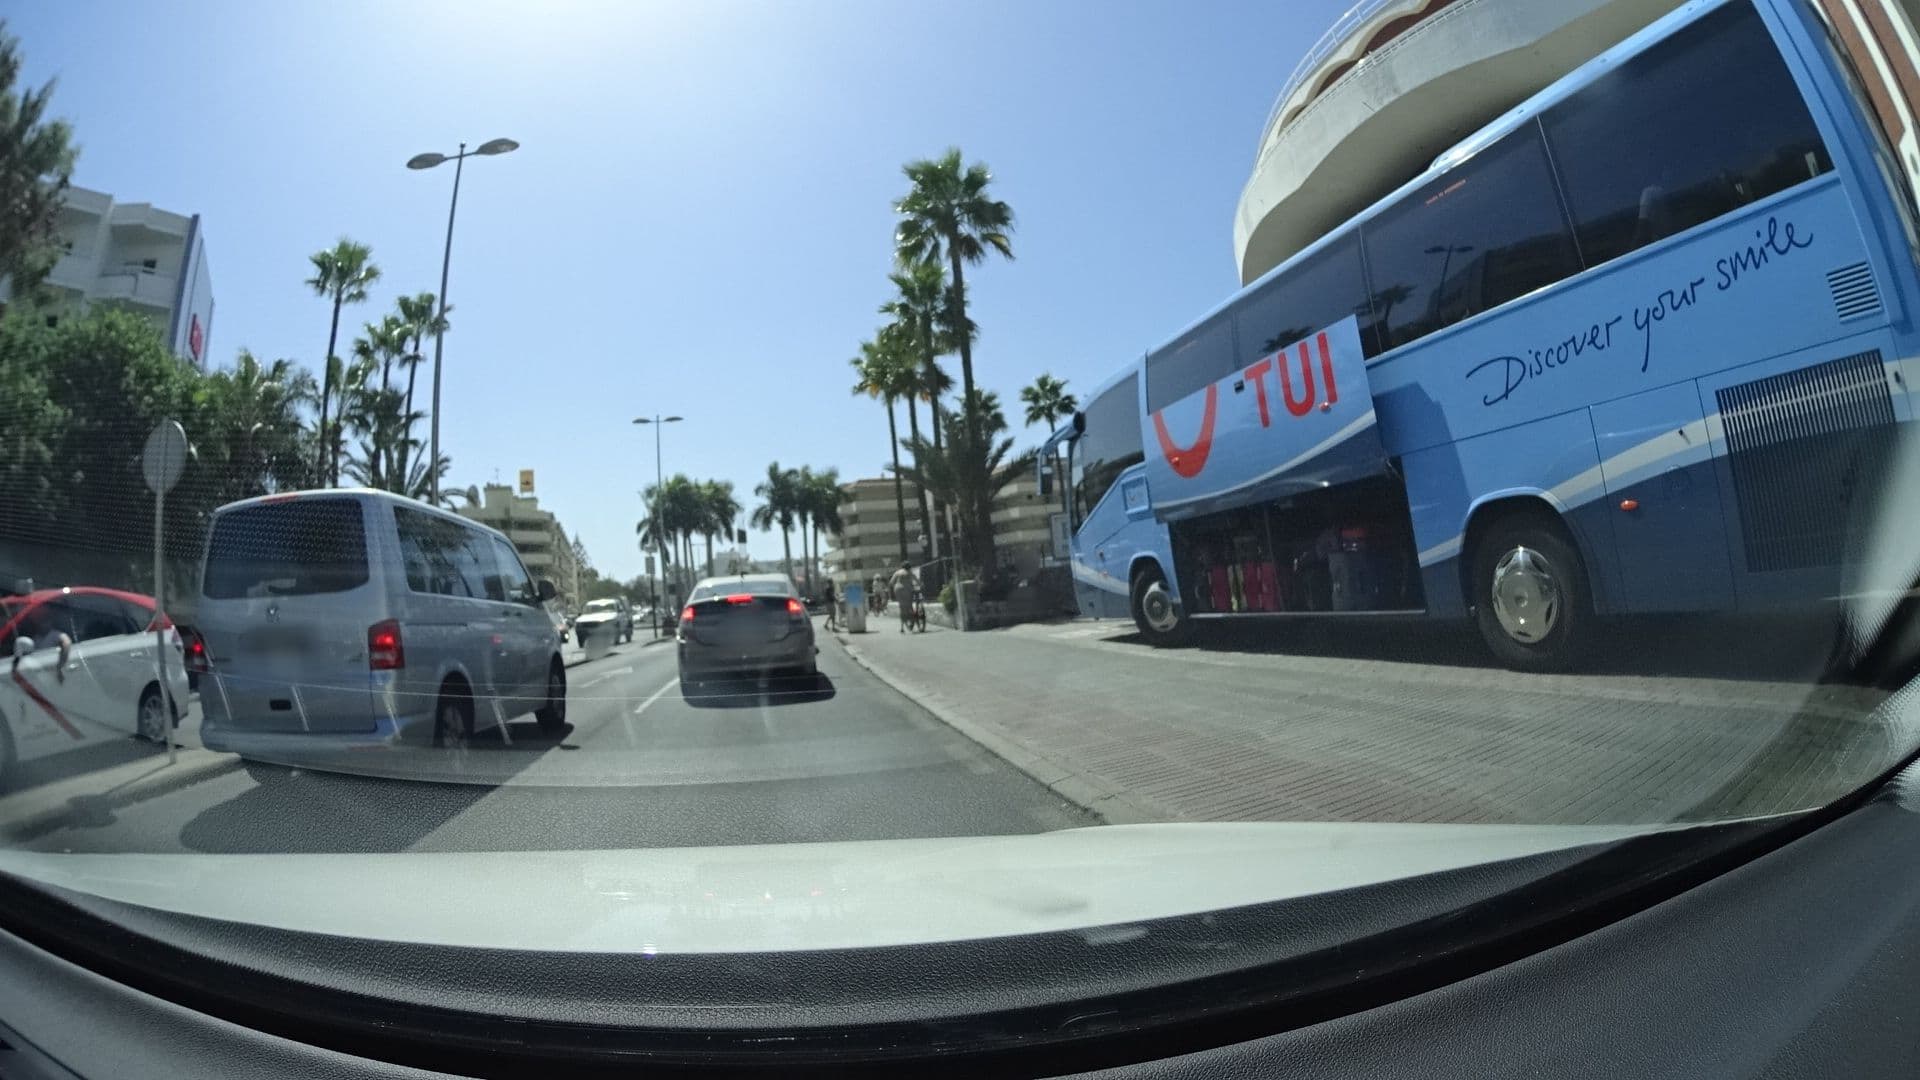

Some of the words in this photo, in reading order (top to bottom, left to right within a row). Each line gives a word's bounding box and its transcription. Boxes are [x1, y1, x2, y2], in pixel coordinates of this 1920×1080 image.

[1244, 331, 1338, 428] TUI
[1466, 315, 1622, 406] Discover
[1634, 278, 1705, 372] your
[1716, 216, 1814, 290] smile
